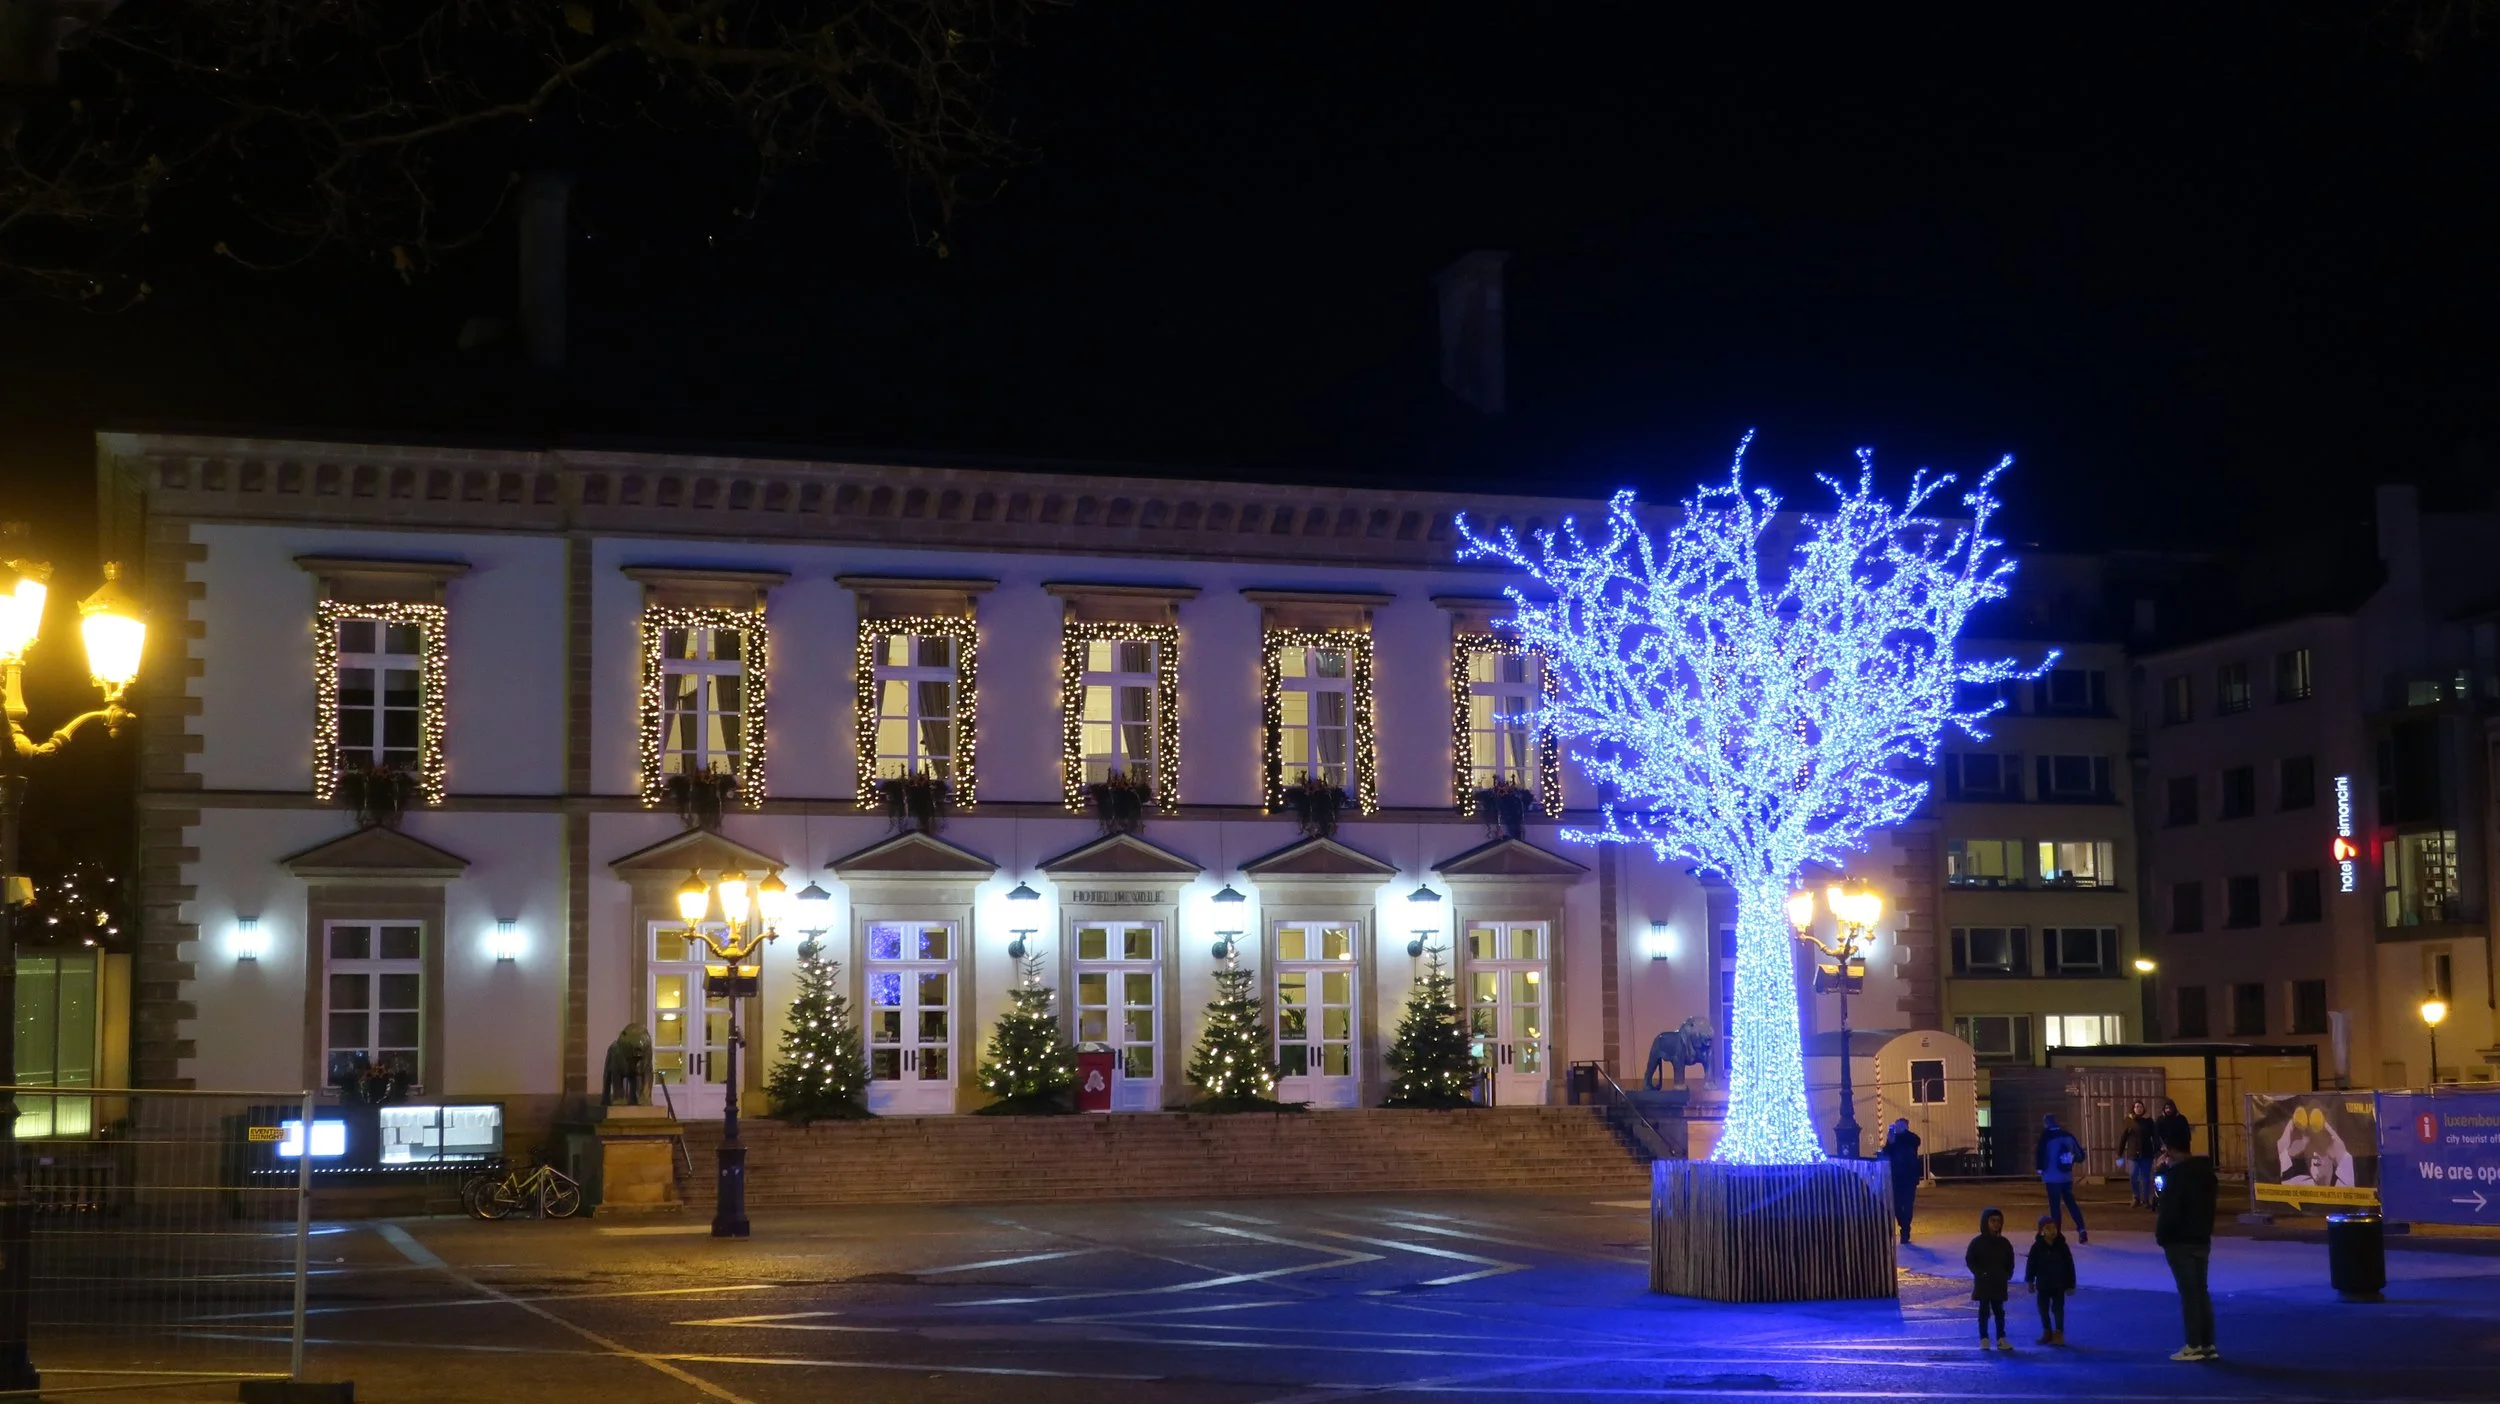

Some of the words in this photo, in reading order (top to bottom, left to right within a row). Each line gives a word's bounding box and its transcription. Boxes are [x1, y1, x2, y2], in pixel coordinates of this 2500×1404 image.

[2334, 777, 2350, 837] simoncini
[2339, 860, 2353, 892] hotel
[2446, 1134, 2460, 1145] city
[2462, 1134, 2488, 1144] tourist
[2419, 1161, 2443, 1180] We
[2447, 1166, 2473, 1180] are
